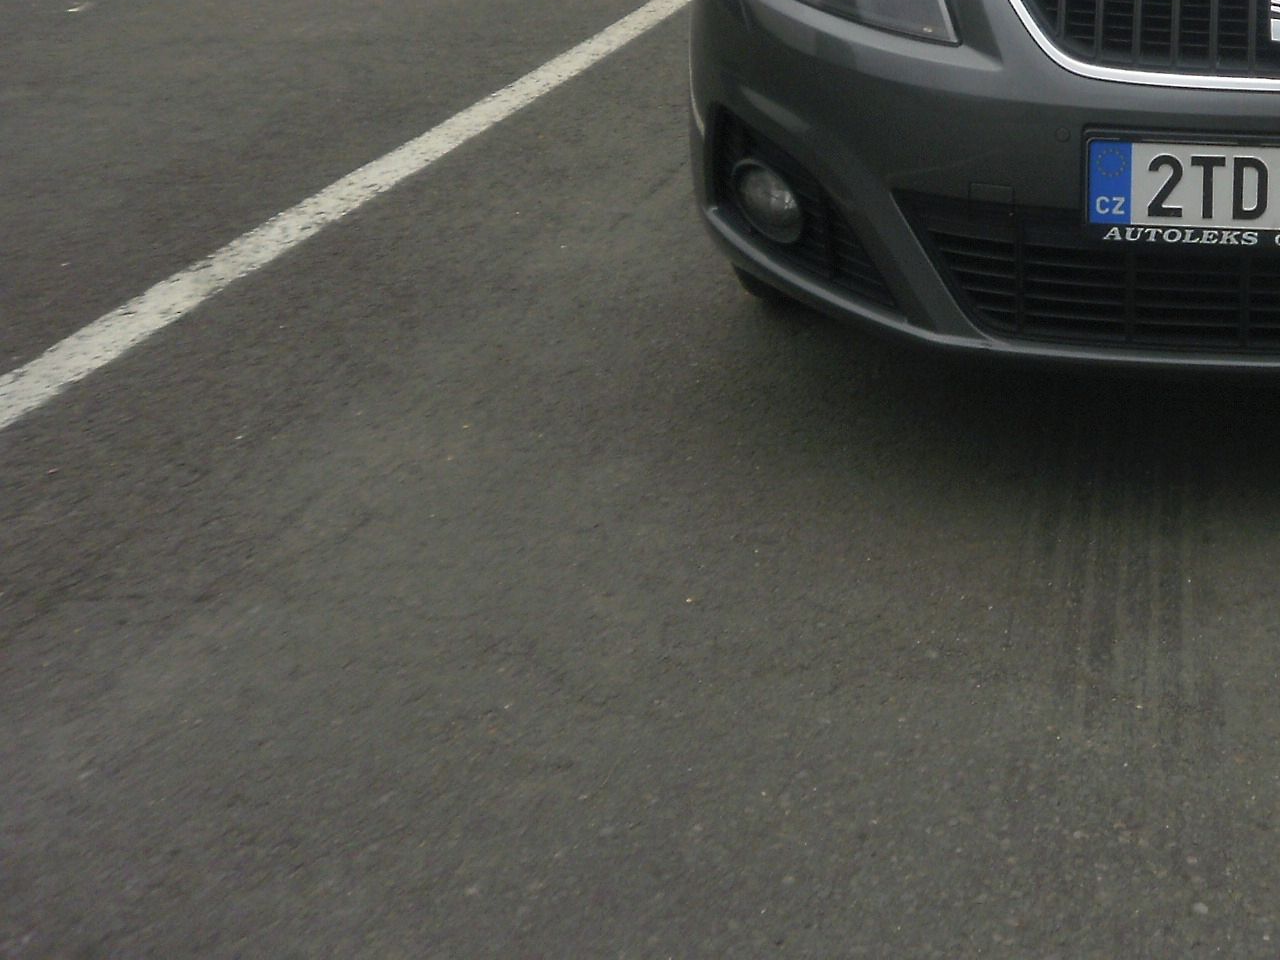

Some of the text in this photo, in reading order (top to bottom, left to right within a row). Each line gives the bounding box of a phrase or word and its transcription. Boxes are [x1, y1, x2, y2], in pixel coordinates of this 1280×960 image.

[1147, 154, 1269, 221] 2TD
[1095, 195, 1125, 215] CZ
[1103, 227, 1258, 246] AUTOLEKS
